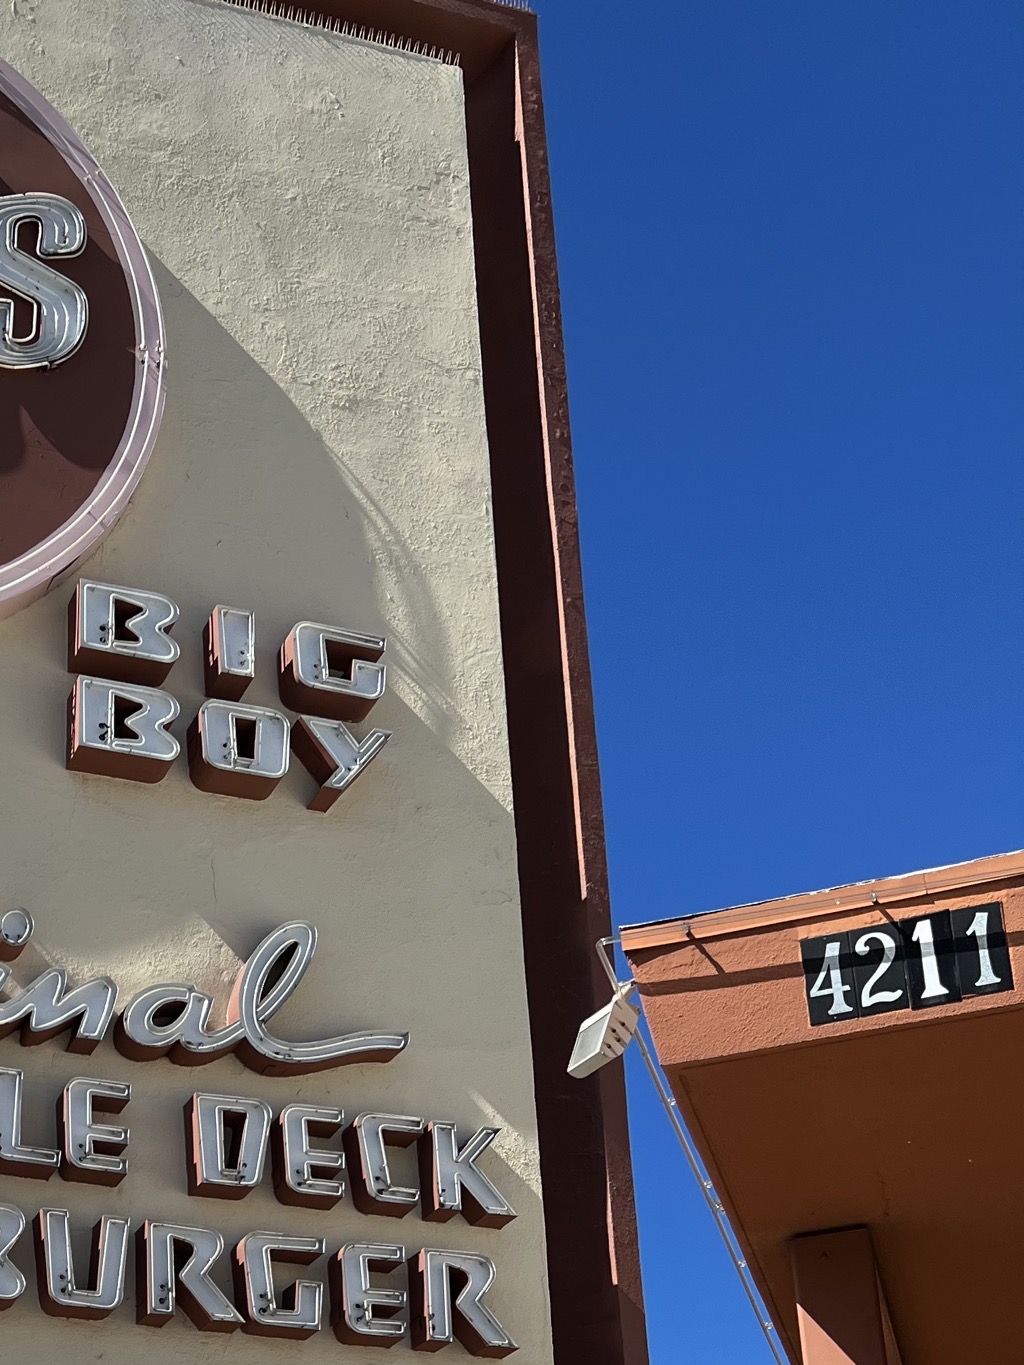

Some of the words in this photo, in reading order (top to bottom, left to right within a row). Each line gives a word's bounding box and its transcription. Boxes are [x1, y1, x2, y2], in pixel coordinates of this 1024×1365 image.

[72, 578, 387, 708] BIG
[70, 674, 393, 802] BOY
[810, 912, 1002, 1015] 4211
[187, 1092, 517, 1223] DECK
